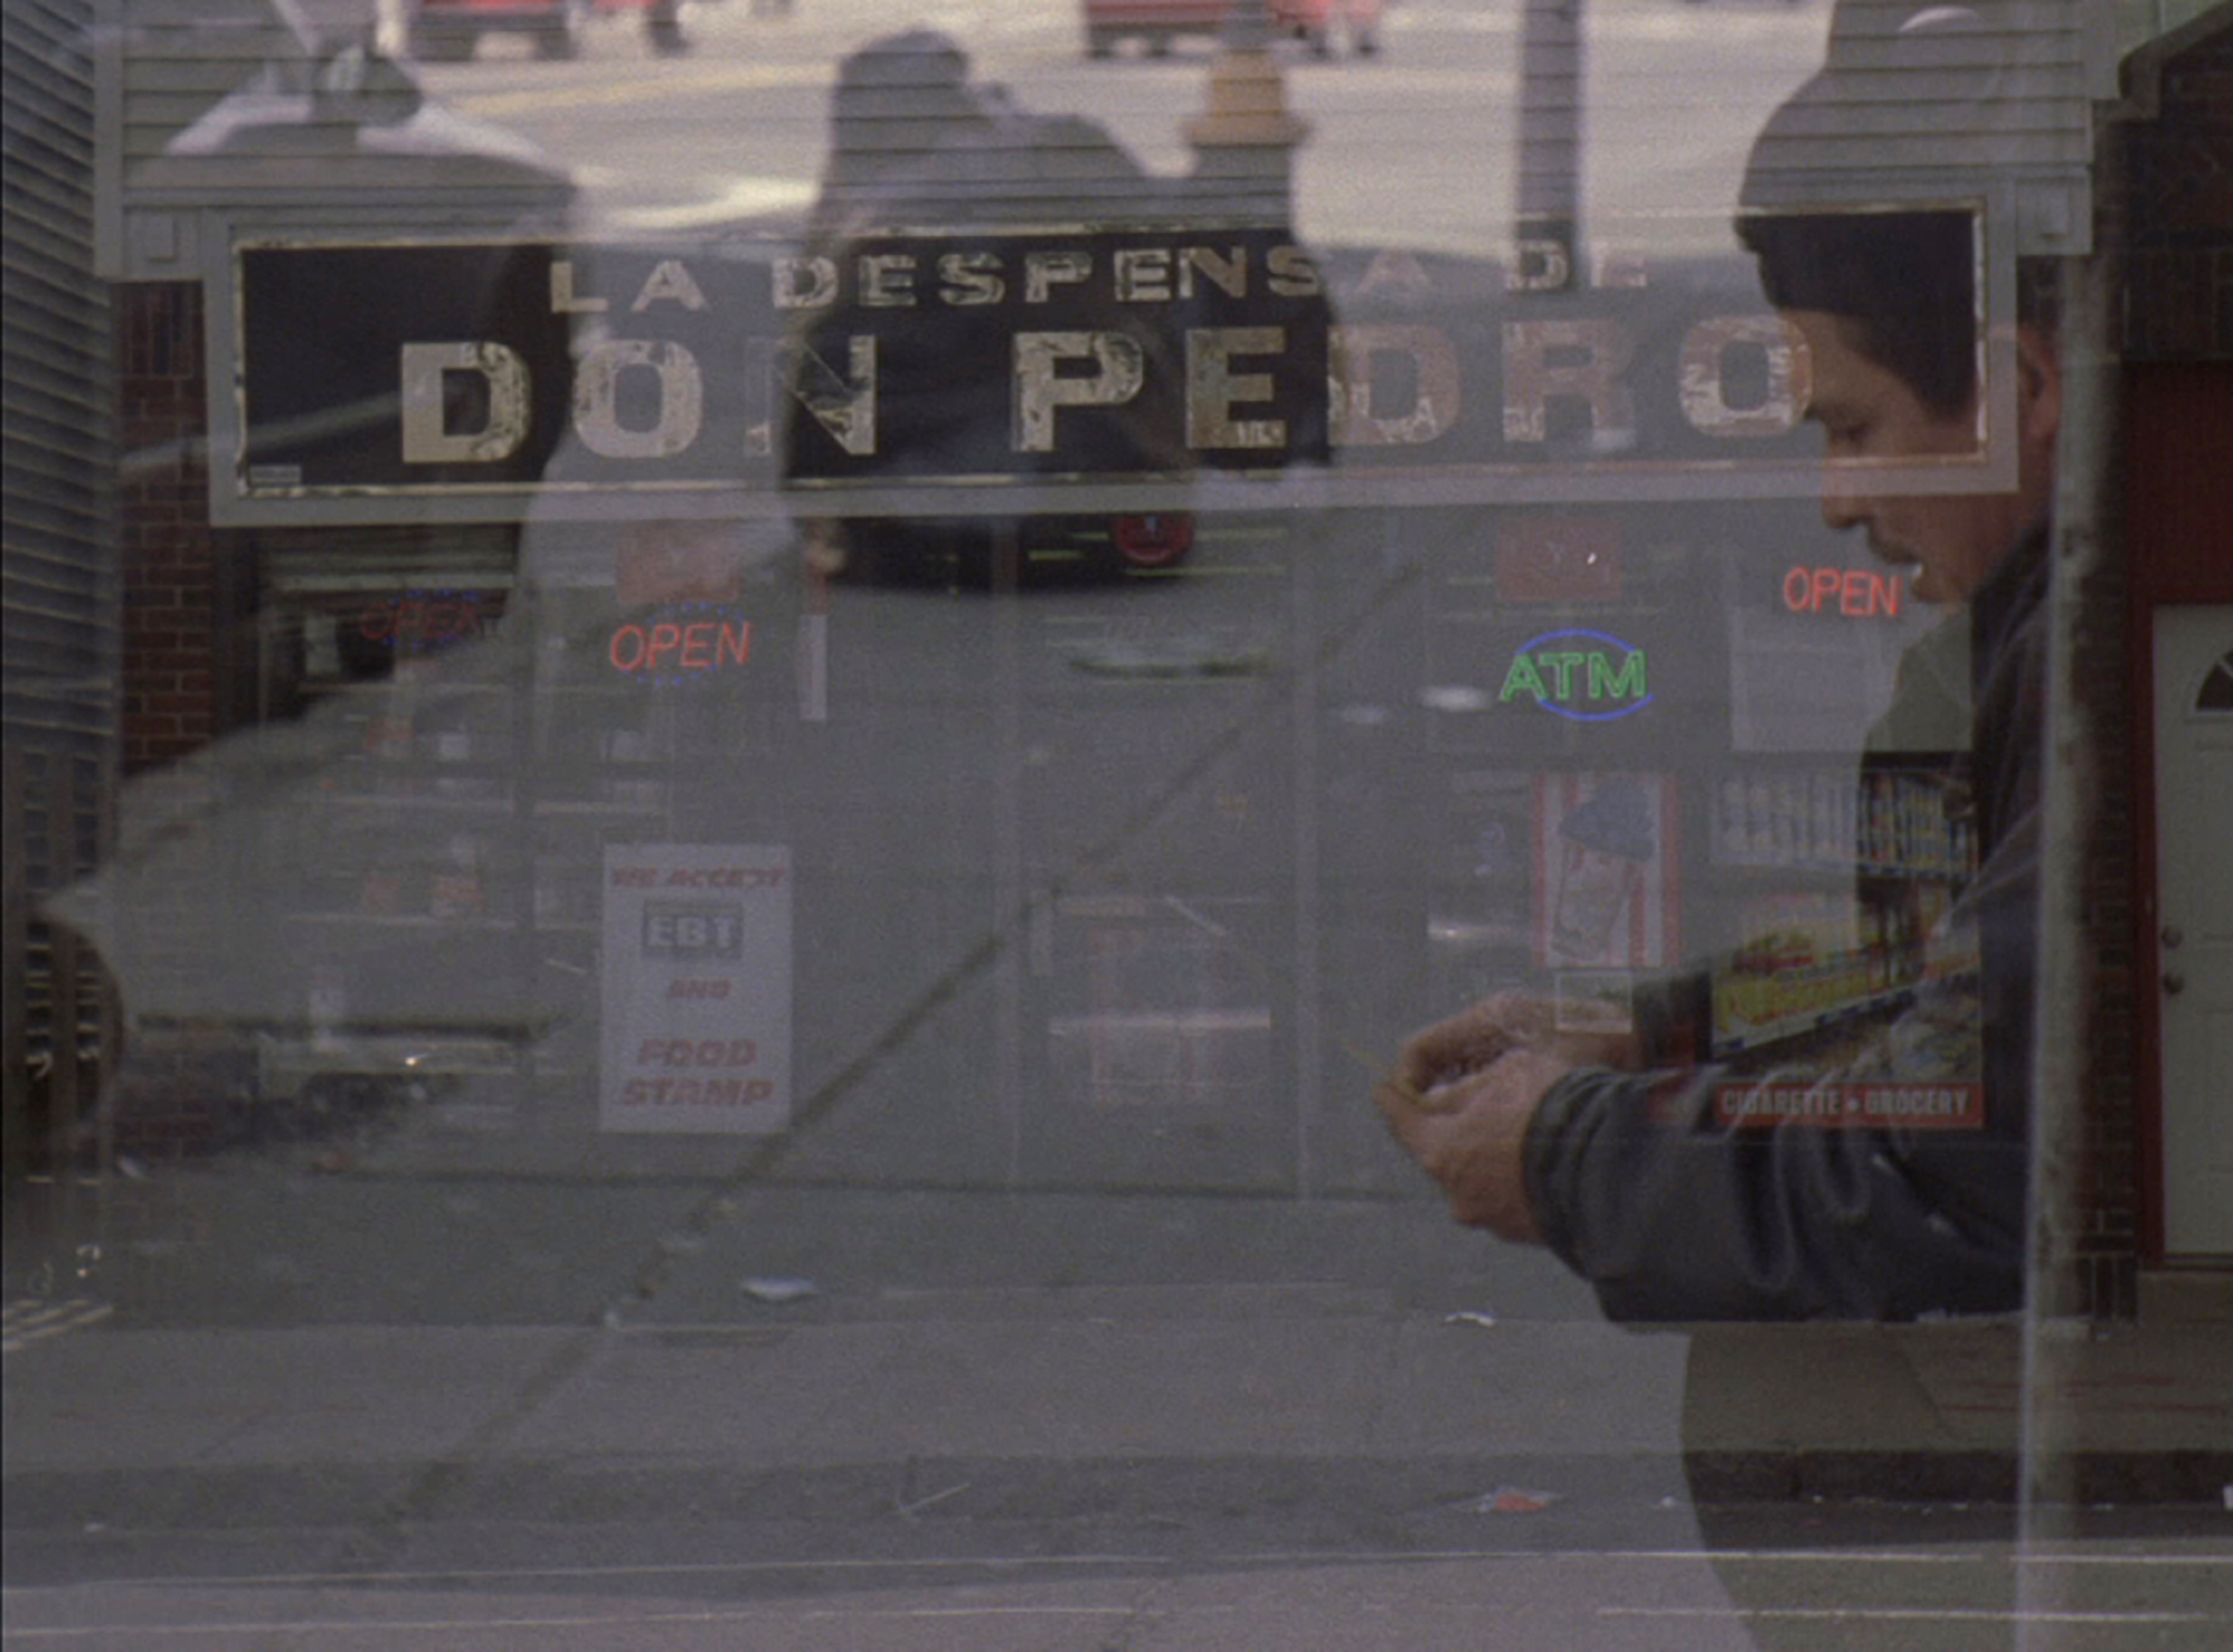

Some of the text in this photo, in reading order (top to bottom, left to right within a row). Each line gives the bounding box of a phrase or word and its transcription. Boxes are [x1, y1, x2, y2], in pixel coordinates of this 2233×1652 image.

[550, 258, 709, 312] LA
[401, 315, 1813, 463] DON PEDRO
[1783, 565, 1903, 616] OPEN
[609, 620, 753, 671] OPEN
[1498, 649, 1649, 702] ATM
[646, 913, 736, 949] EBT
[667, 977, 733, 1001] AND
[637, 1037, 758, 1068] FOOD
[621, 1078, 775, 1106] STAMP
[1720, 1087, 1971, 1116] CIGARETTE GROCERY
